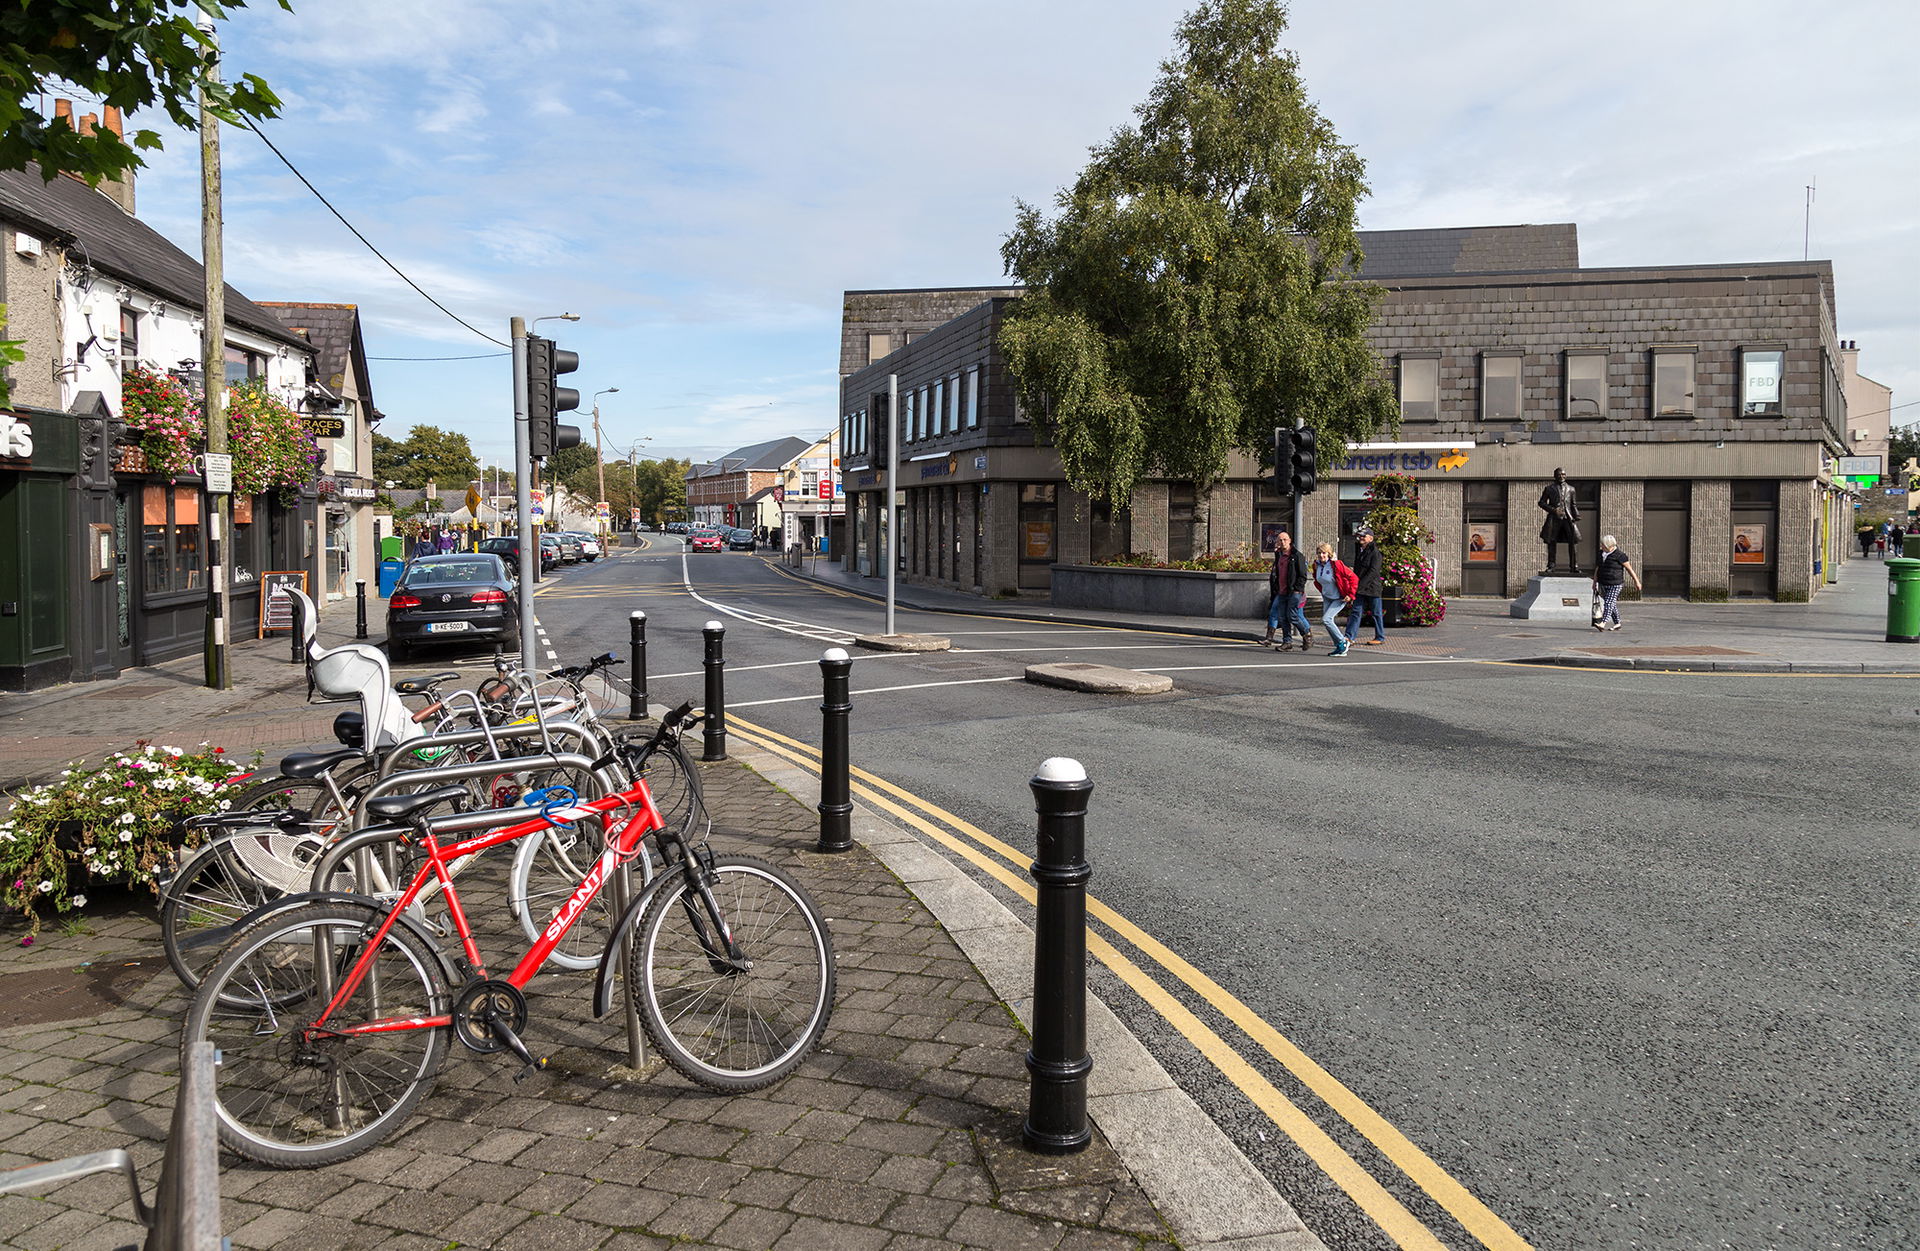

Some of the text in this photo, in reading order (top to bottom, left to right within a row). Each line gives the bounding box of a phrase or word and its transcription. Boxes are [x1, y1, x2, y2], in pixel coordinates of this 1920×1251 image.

[1749, 376, 1775, 387] FBD
[302, 420, 342, 429] RACES
[1401, 450, 1432, 470] tsb
[1843, 460, 1875, 472] FBD
[546, 867, 601, 941] SLANT
